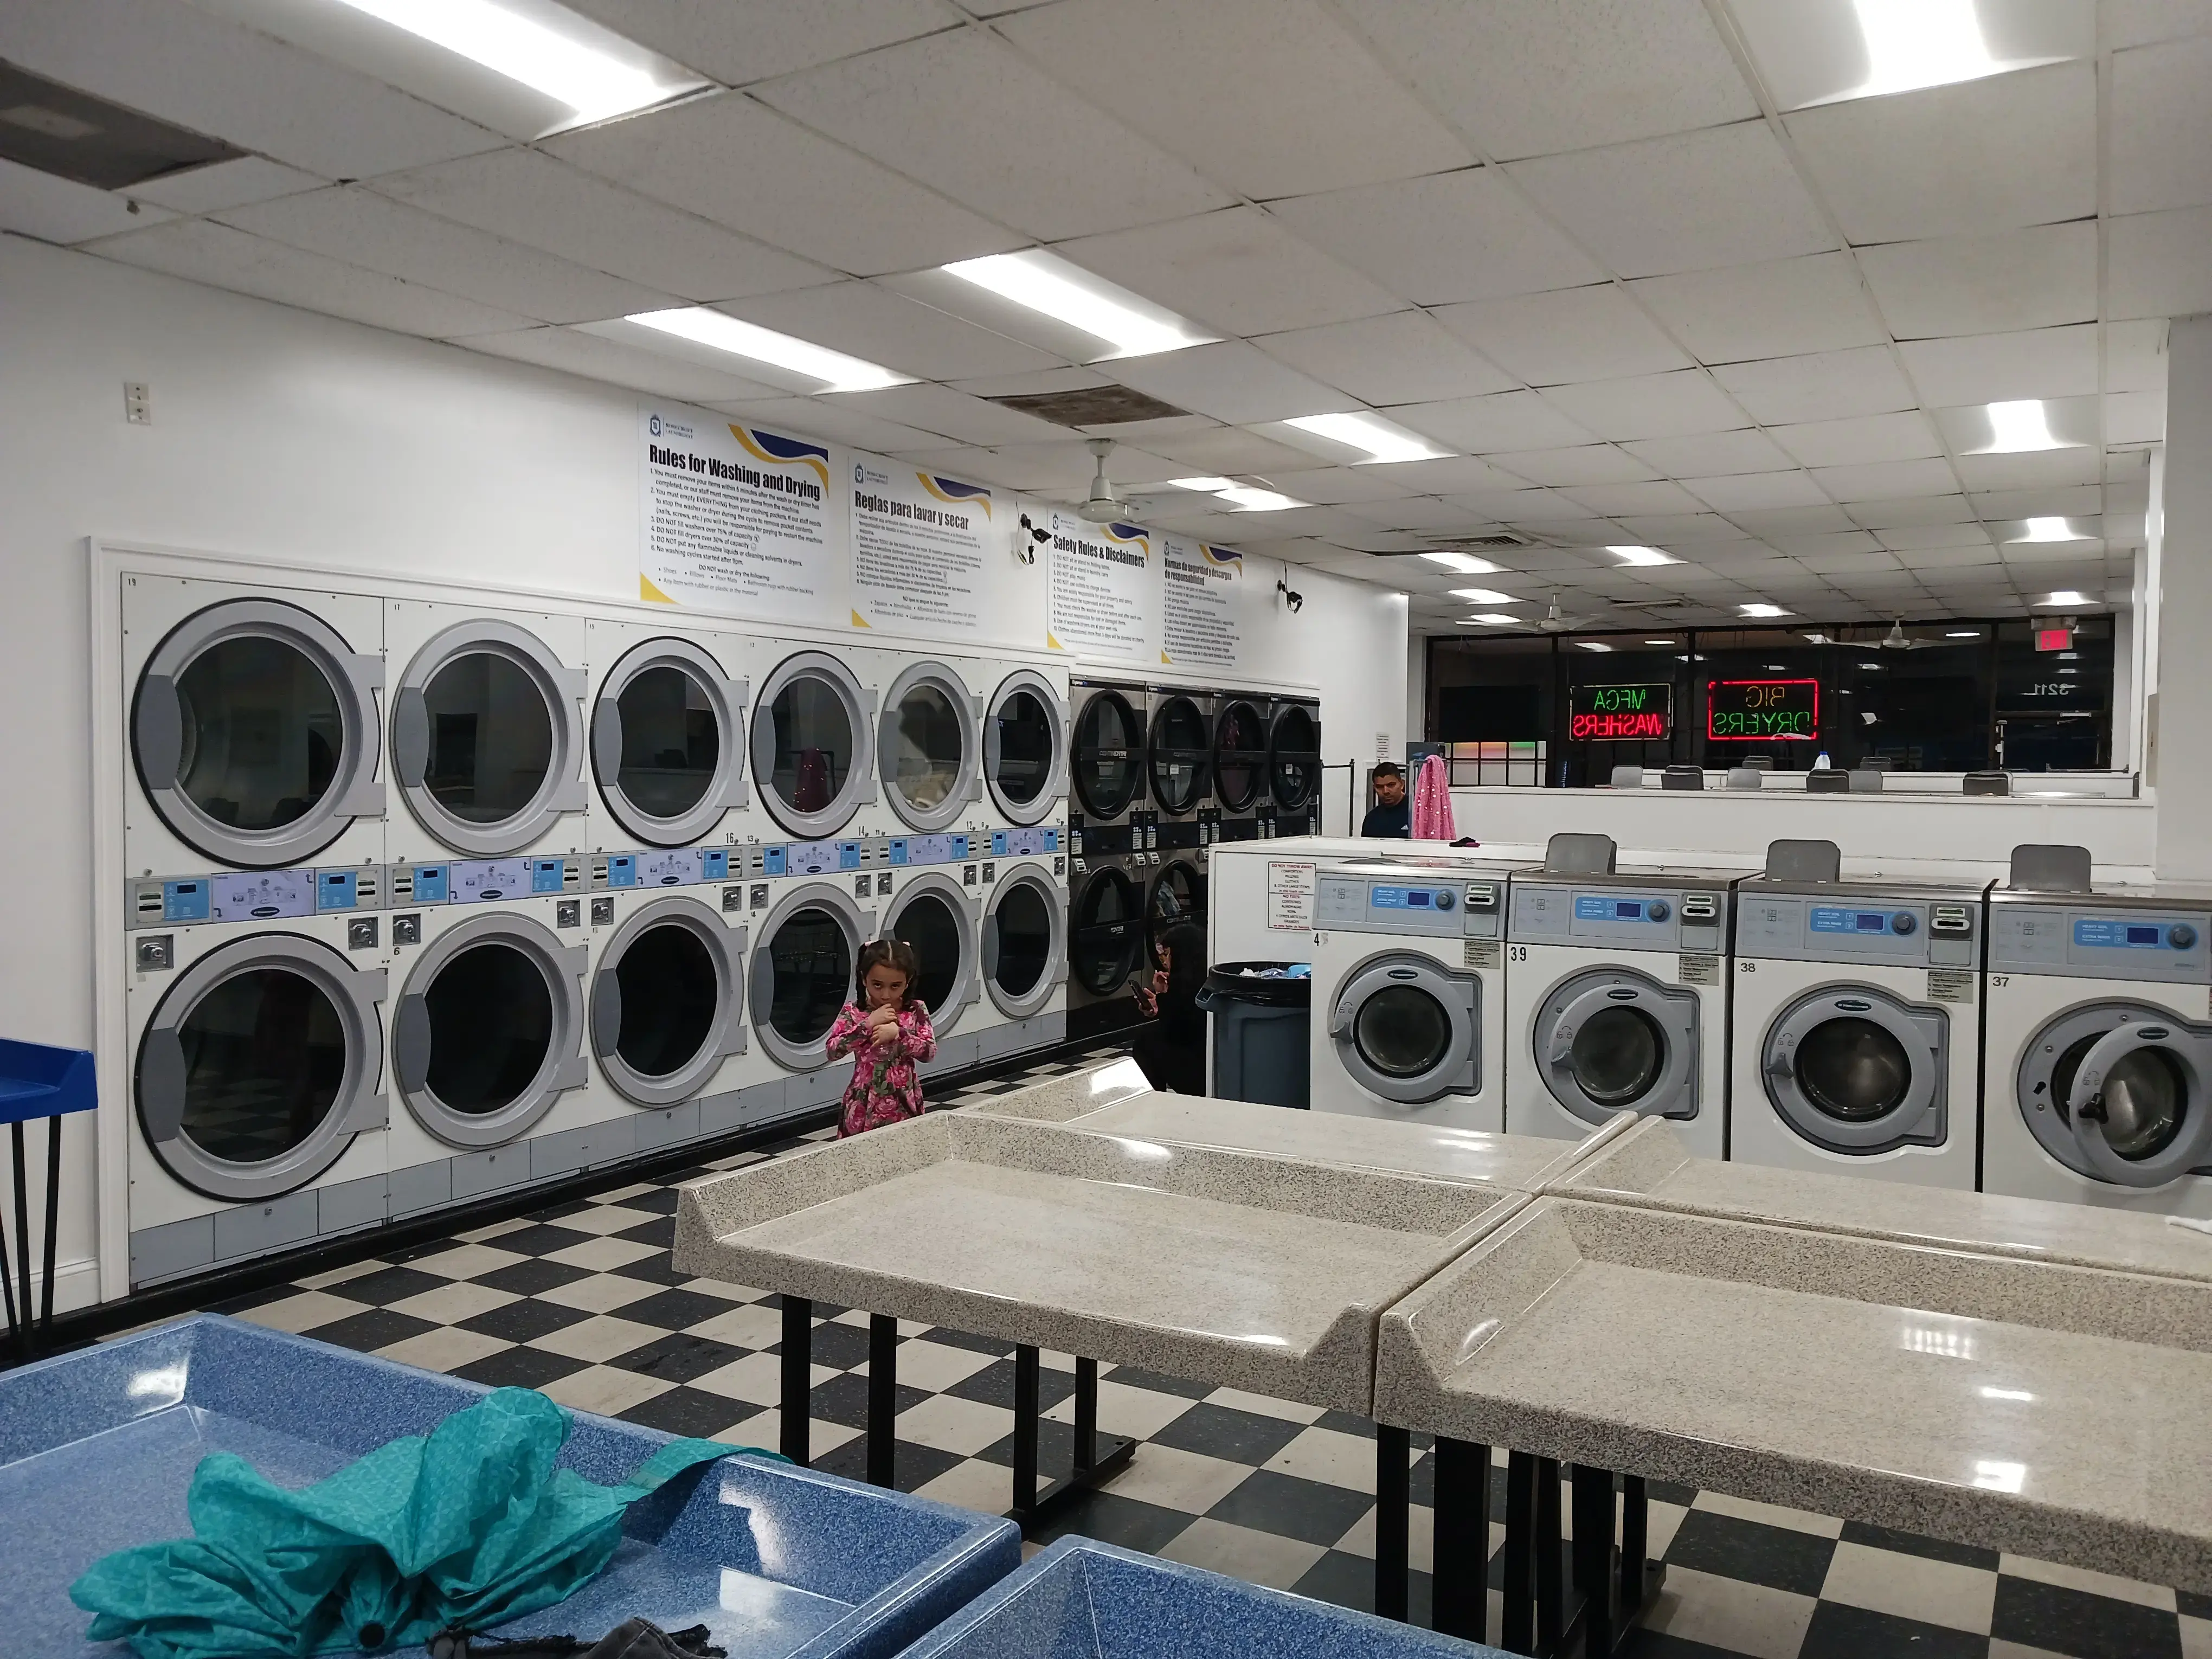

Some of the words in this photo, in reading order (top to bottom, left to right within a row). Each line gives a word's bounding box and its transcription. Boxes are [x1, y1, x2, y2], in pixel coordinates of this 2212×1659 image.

[650, 444, 685, 469] Rules
[689, 453, 706, 474] for
[709, 458, 760, 488] Washing
[763, 473, 783, 491] and
[786, 476, 820, 501] Drying
[680, 494, 695, 502] empty
[697, 496, 727, 507] EVERYTHING
[855, 490, 888, 513] Reglas
[891, 501, 911, 518] para
[914, 504, 936, 523] lavar
[938, 512, 943, 525] y
[945, 514, 969, 530] secar
[722, 511, 736, 520] during
[734, 532, 753, 541] capacity
[730, 541, 748, 549] capacity
[665, 548, 685, 557] washing
[745, 551, 763, 561] cleaning
[1053, 535, 1076, 554] Safety
[1078, 540, 1097, 557] Rules
[1099, 547, 1104, 559] &
[1106, 546, 1144, 568] Disclaimers
[1165, 557, 1181, 569] Normas
[1182, 562, 1187, 571] de
[1188, 564, 1208, 575] seguridad
[1165, 569, 1170, 579] de
[128, 578, 136, 586] 19
[966, 820, 972, 830] 12
[858, 826, 865, 836] 14
[726, 832, 734, 844] 16
[1314, 933, 1320, 947] 4
[394, 947, 400, 956] 6
[1510, 947, 1527, 961] 39
[1740, 962, 1756, 973] 38
[1992, 977, 2010, 987] 37
